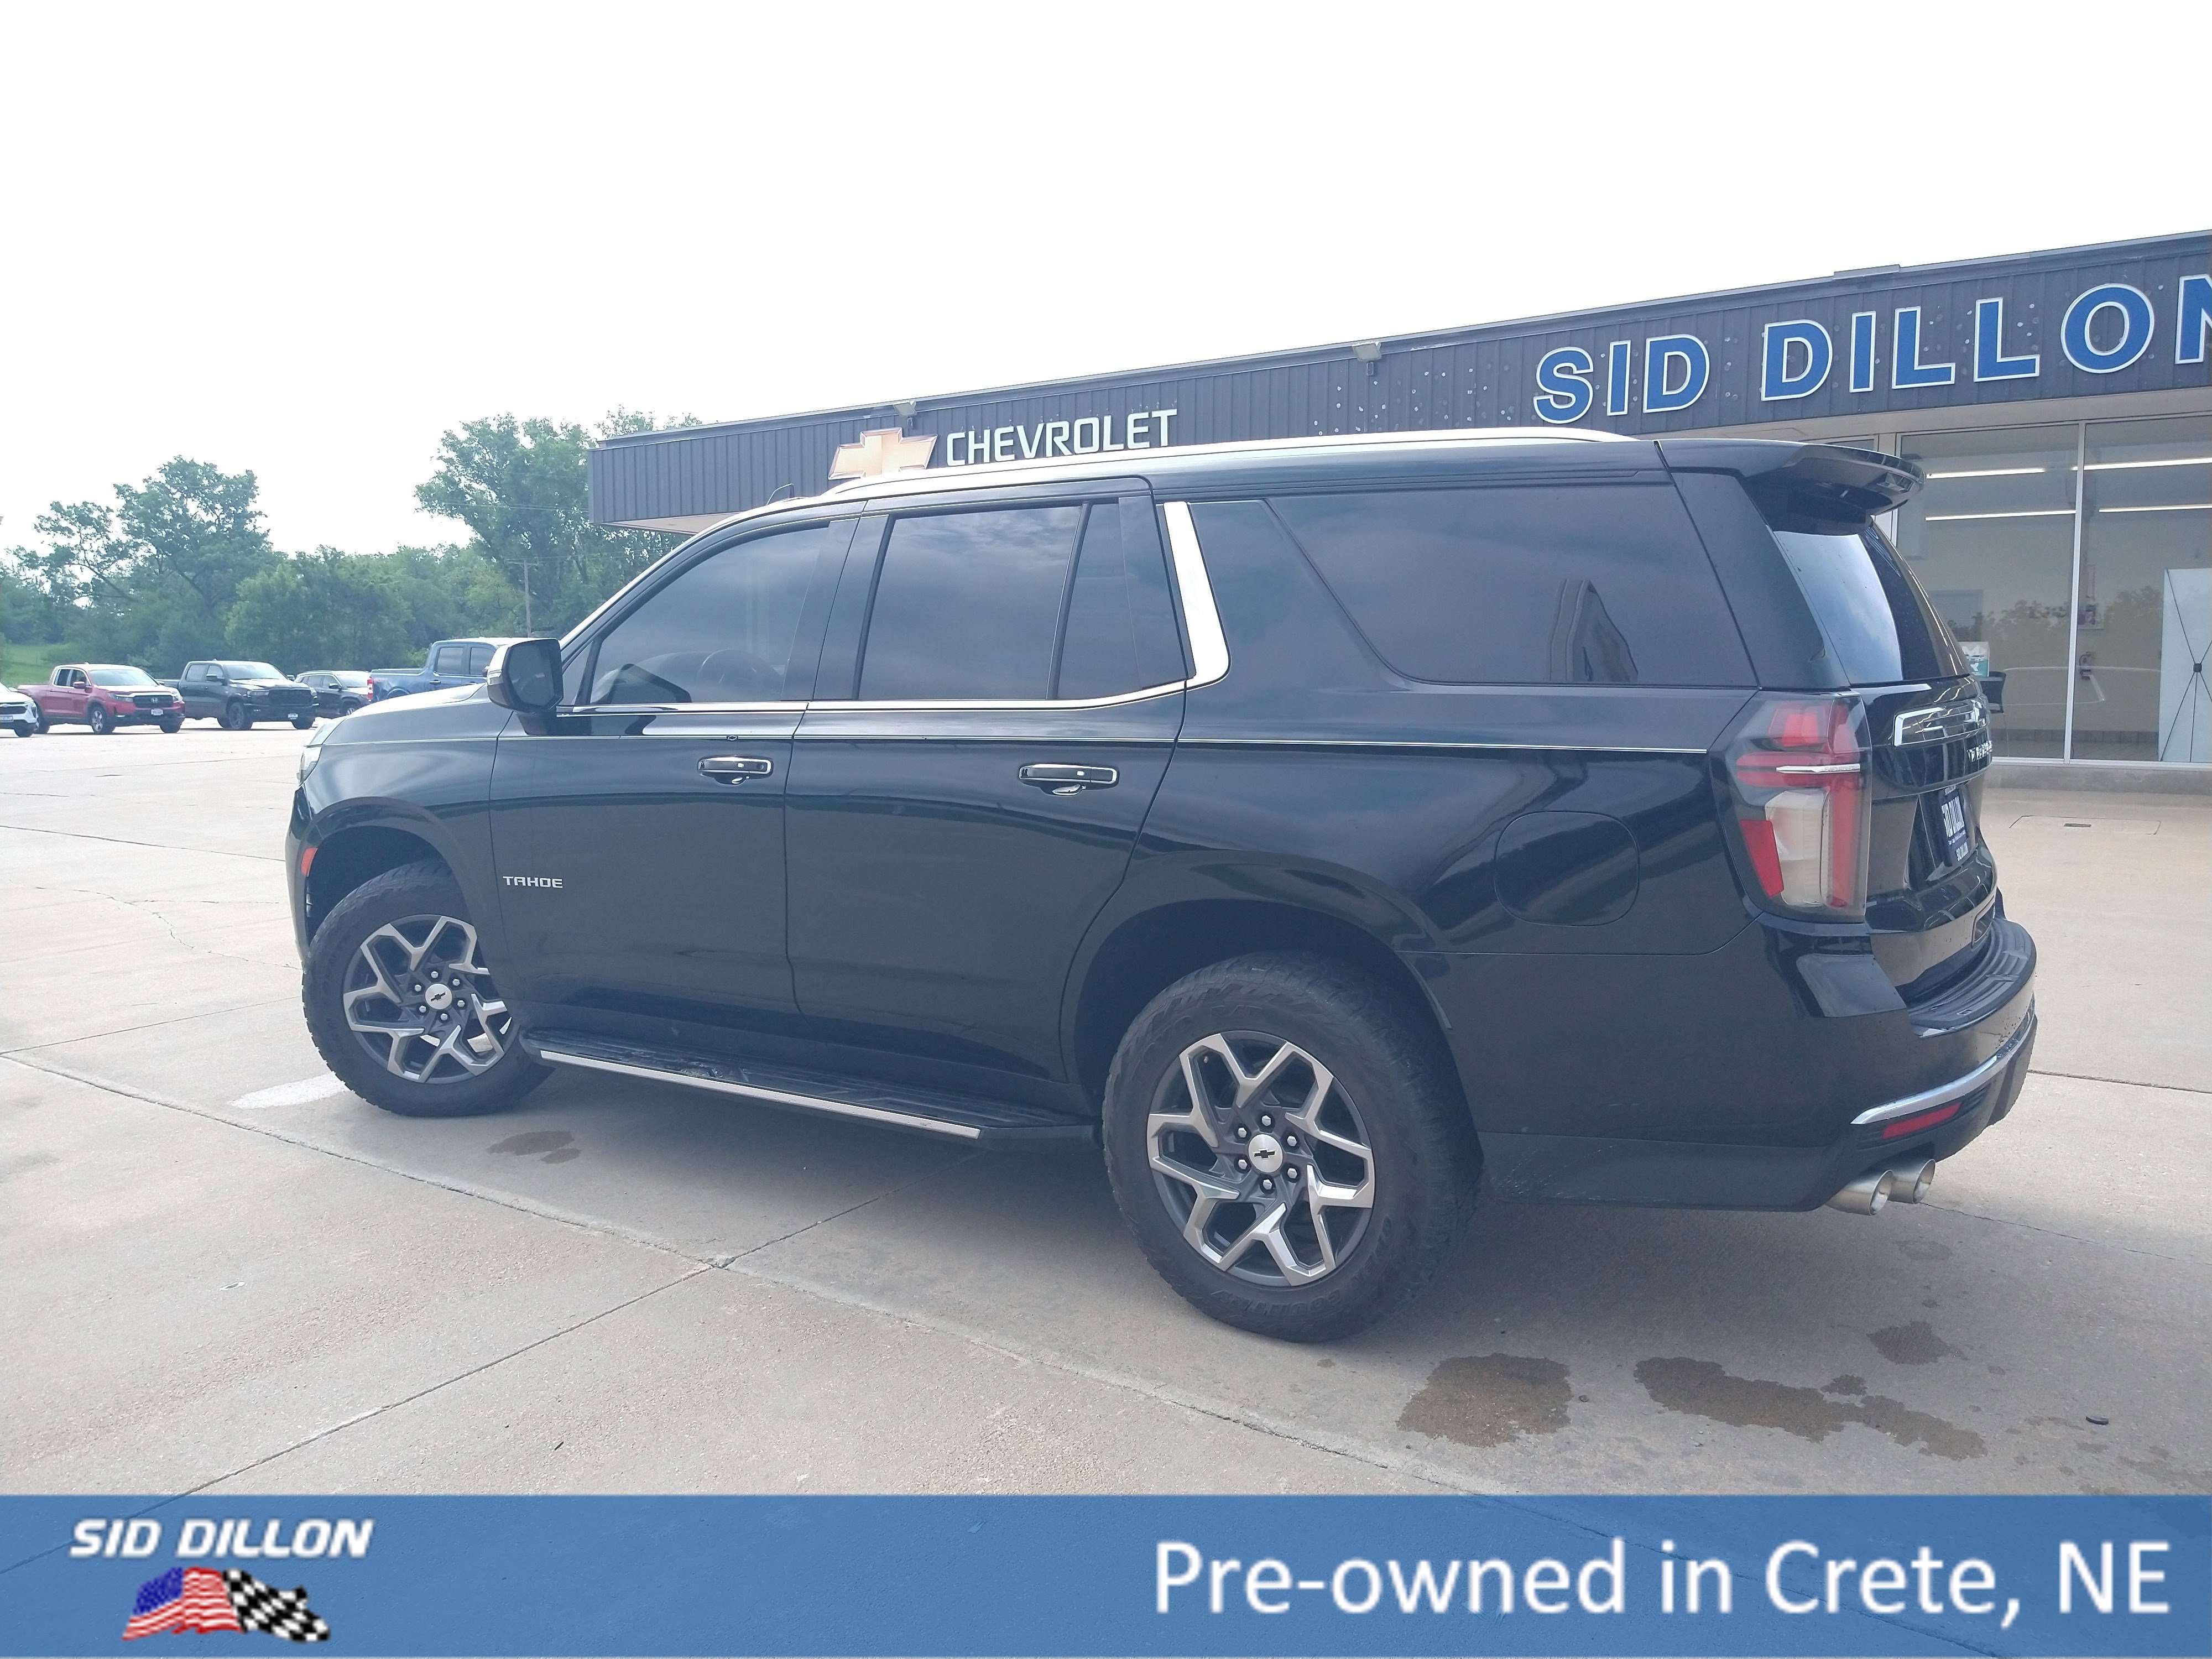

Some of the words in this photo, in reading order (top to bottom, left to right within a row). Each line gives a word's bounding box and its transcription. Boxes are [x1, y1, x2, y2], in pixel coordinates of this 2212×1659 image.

[1533, 333, 1710, 424] SID
[946, 409, 1178, 467] CHEVROLET
[502, 876, 564, 888] TAHOE
